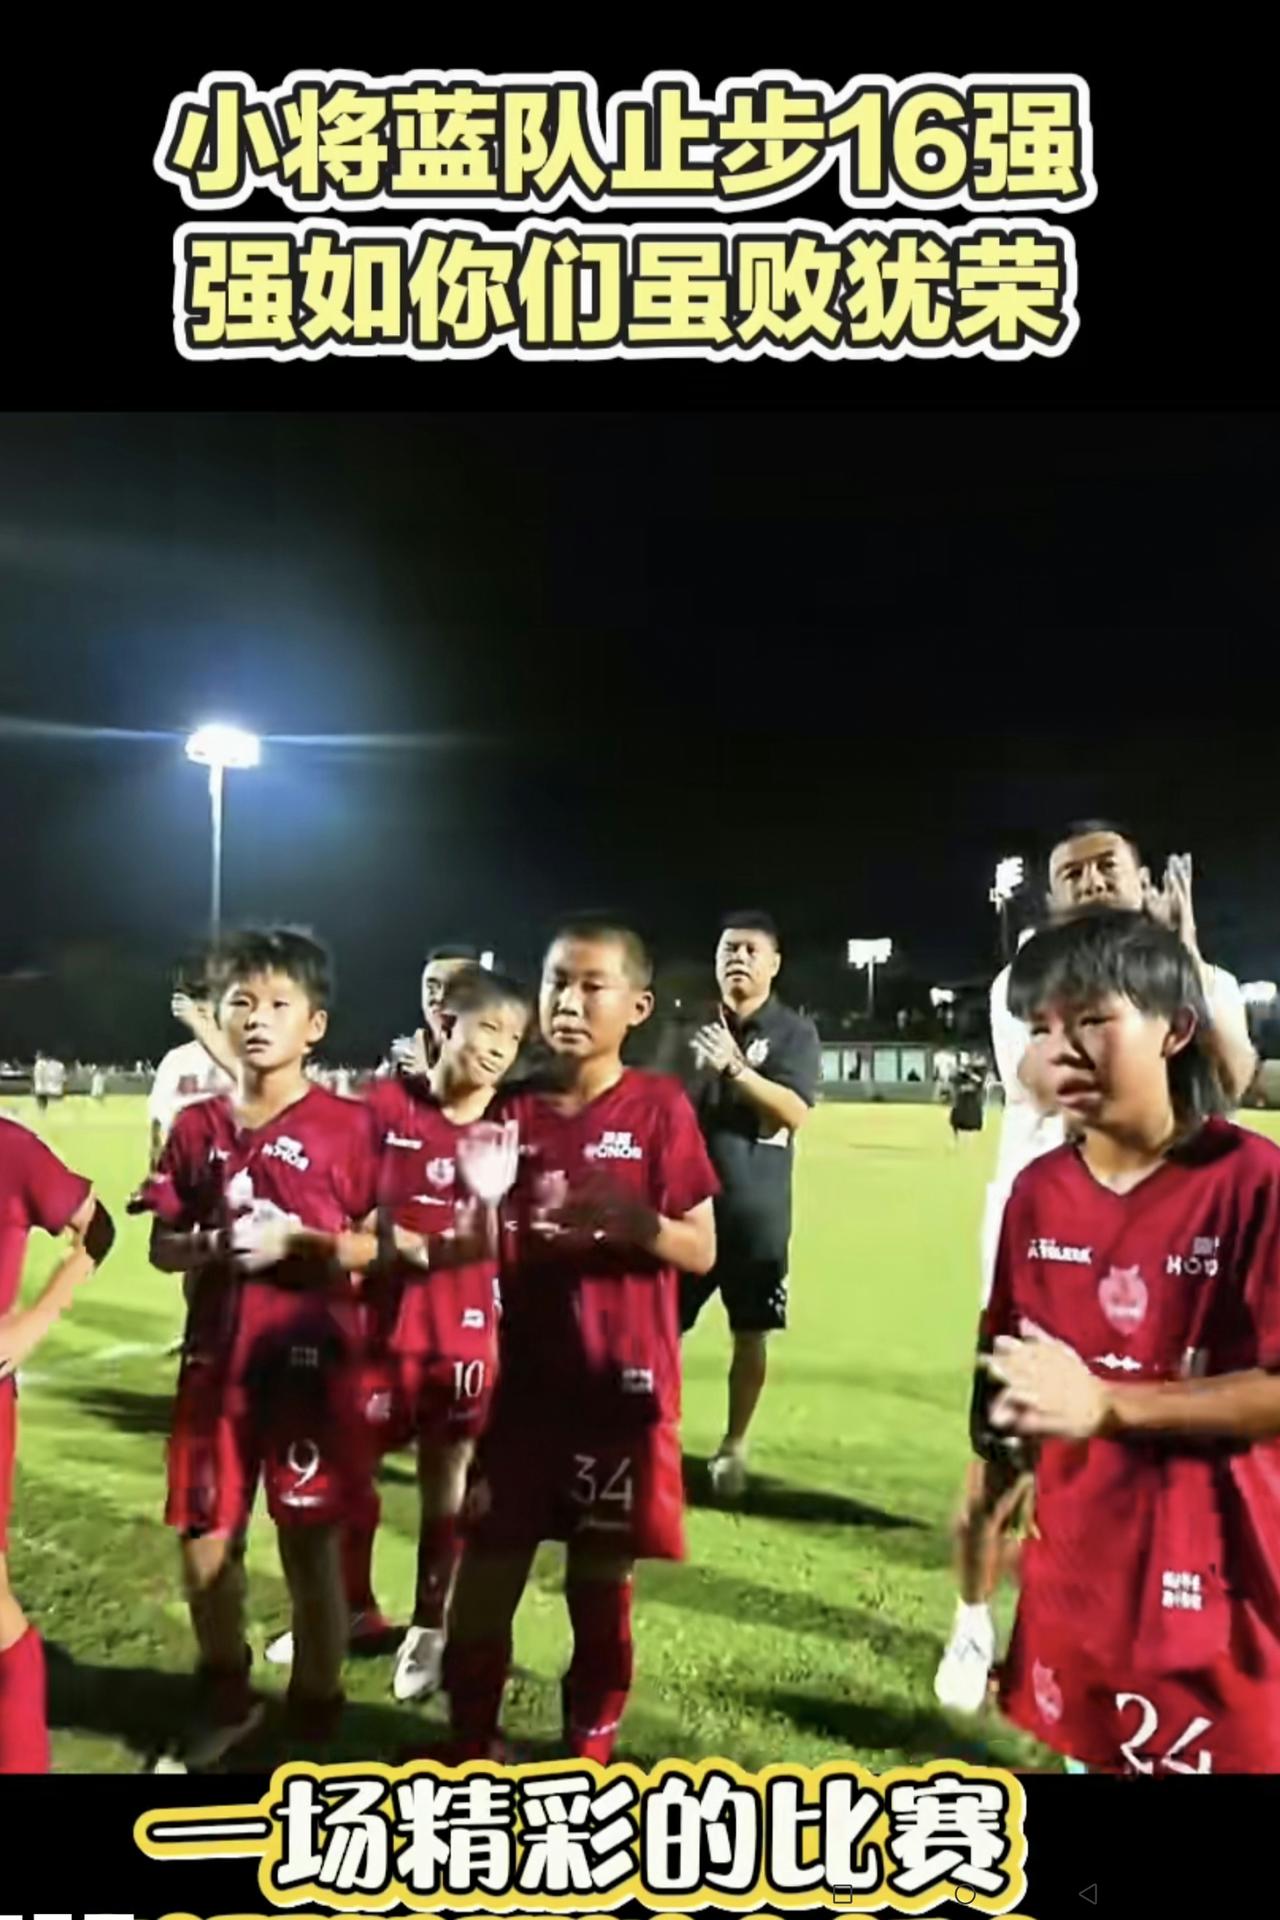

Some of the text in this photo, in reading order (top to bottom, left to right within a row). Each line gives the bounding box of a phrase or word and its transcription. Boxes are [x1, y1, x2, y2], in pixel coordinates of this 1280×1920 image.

[453, 1360, 486, 1398] 10
[288, 1439, 320, 1489] 9
[570, 1453, 634, 1512] 34
[1115, 1692, 1213, 1774] 24
